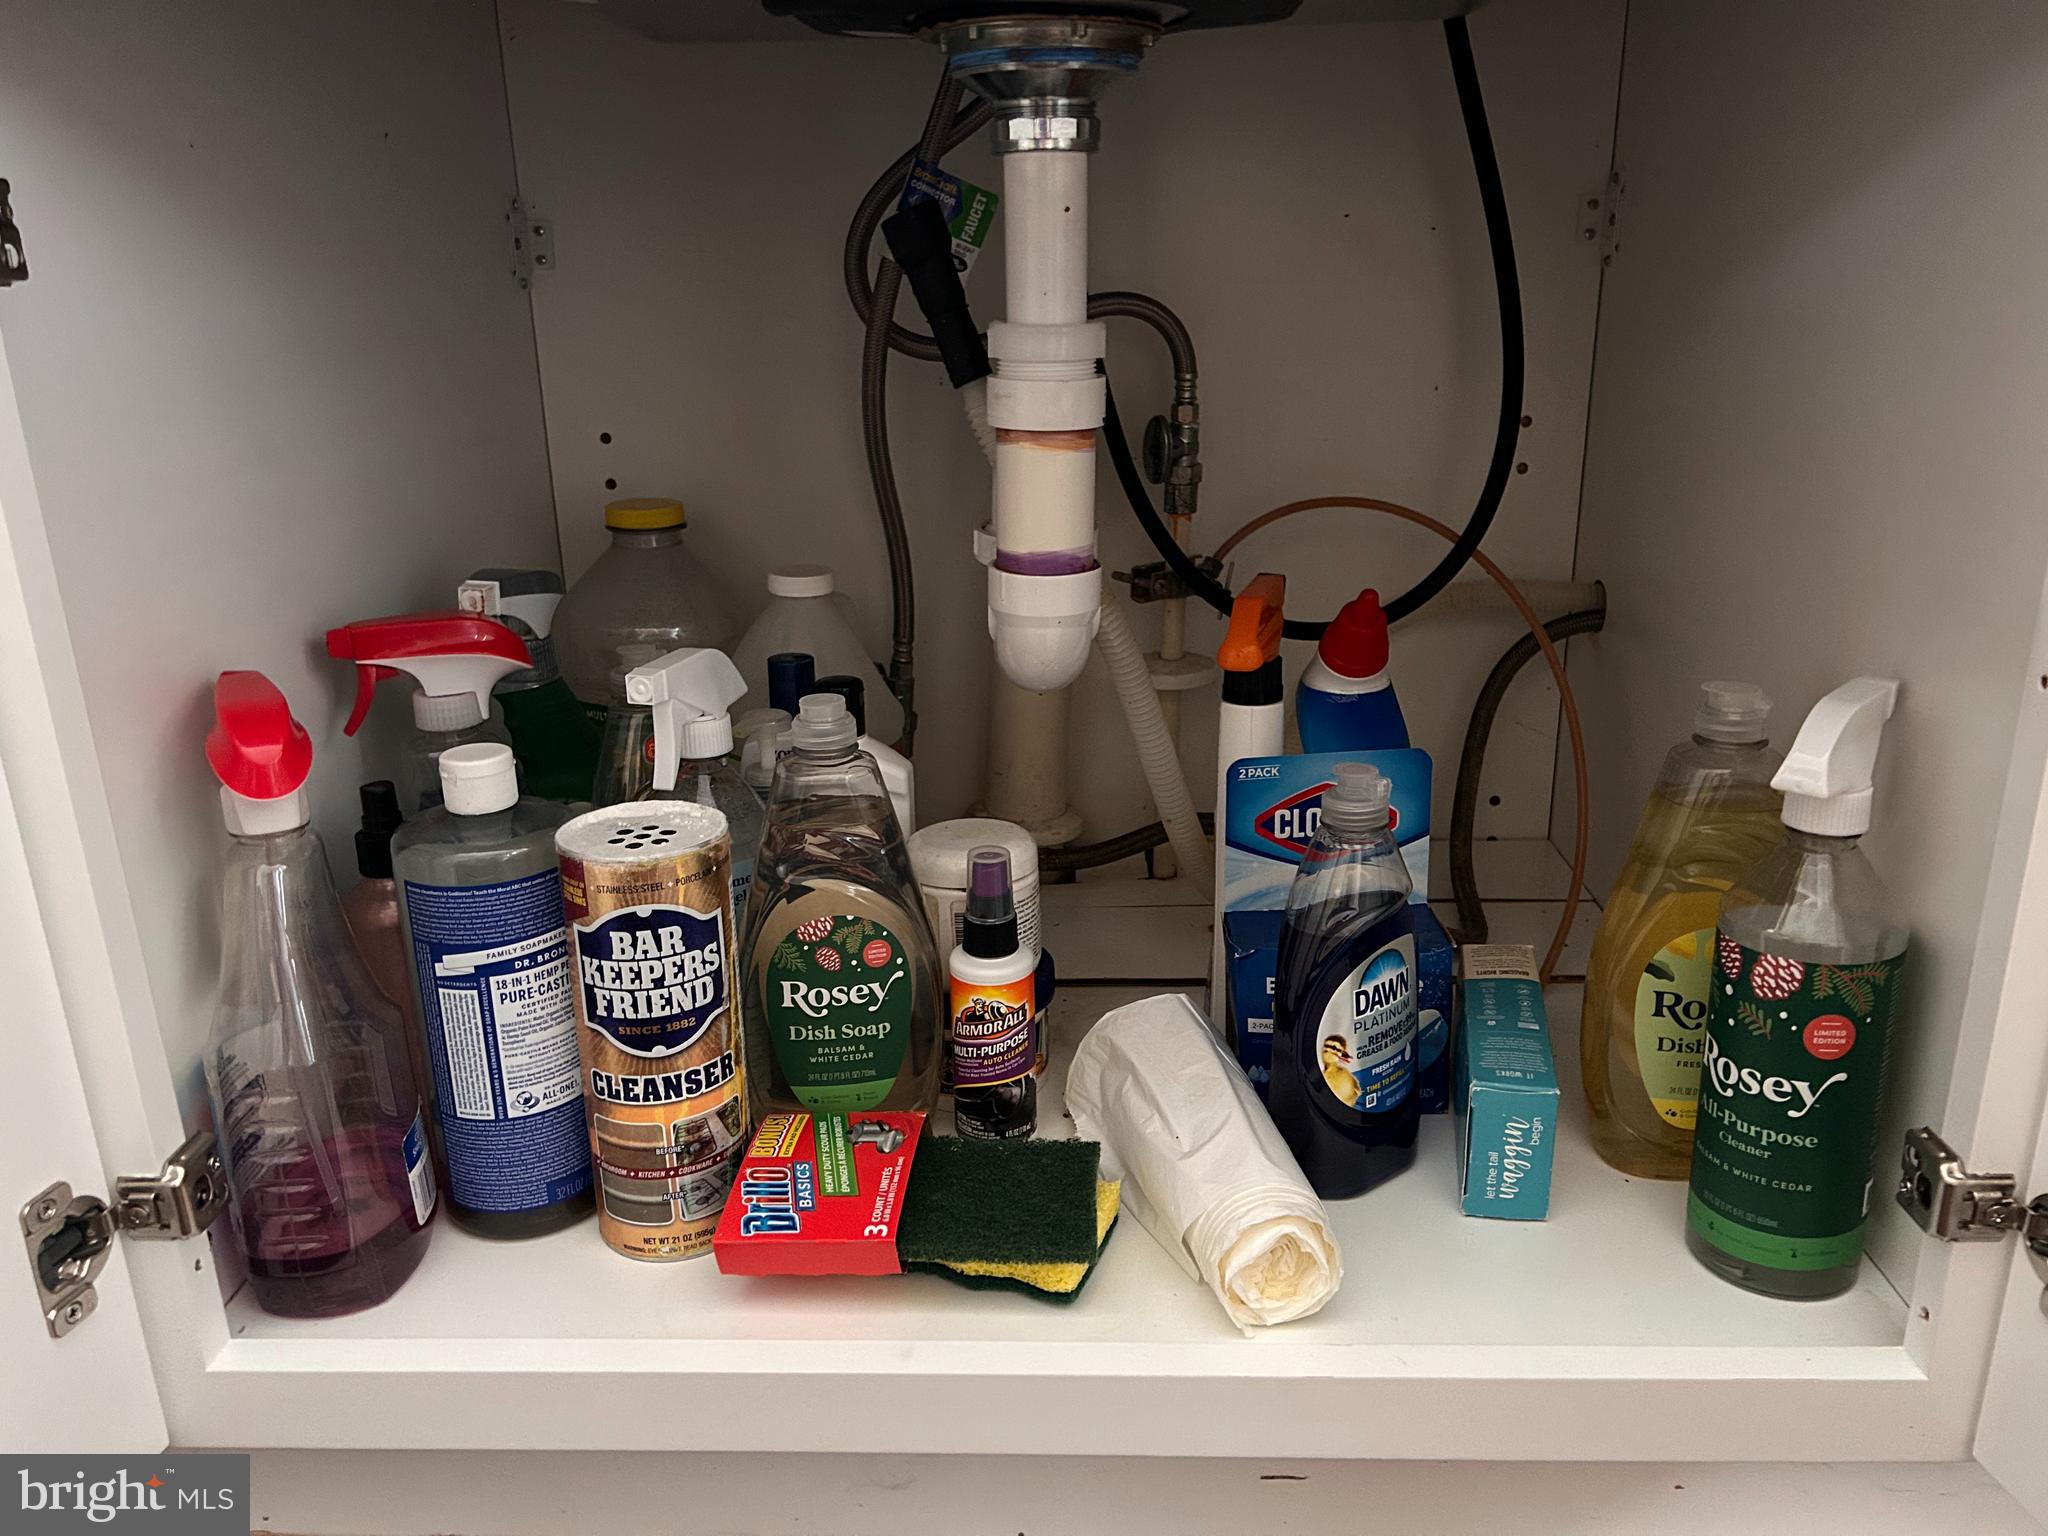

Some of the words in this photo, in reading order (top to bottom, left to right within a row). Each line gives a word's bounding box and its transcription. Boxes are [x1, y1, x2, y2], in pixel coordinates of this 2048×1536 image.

[961, 191, 987, 242] FAUCET
[1239, 769, 1246, 779] 2
[1248, 766, 1280, 778] PACK
[597, 884, 639, 895] STAINLESS
[639, 883, 665, 893] STEEL
[610, 925, 685, 961] BAR
[486, 948, 517, 960] FAMILY
[515, 959, 535, 970] DR.
[582, 941, 720, 990] KEEPERS
[496, 974, 531, 991] 18-IN-1
[534, 964, 559, 982] HEMP
[521, 993, 560, 1009] CERTIFIED
[594, 975, 715, 1019] FRIEND
[780, 970, 905, 1018] Rosey
[1354, 967, 1409, 1018] DAWN
[516, 1008, 538, 1017] MADE
[540, 1001, 558, 1011] WITH
[1354, 998, 1411, 1034] PLATINUM
[618, 1025, 662, 1035] SINCE
[666, 1017, 697, 1032] 1882
[789, 1024, 837, 1041] Dish
[841, 1021, 891, 1040] Soap
[1368, 1019, 1403, 1048] REMOVE
[1813, 1029, 1847, 1037] LIMITED
[817, 1046, 856, 1054] BALSAM
[954, 1027, 1029, 1058] MULTI-PURPOSE
[1813, 1037, 1847, 1045] EDITION
[809, 1055, 839, 1063] WHITE
[843, 1052, 874, 1062] CEDAR
[983, 1055, 1003, 1066] AUTO
[1003, 1041, 1029, 1060] CLEANER
[1357, 1045, 1384, 1060] GREASE
[591, 1051, 735, 1105] CLEANSER
[1372, 1060, 1390, 1076] FRESH
[1703, 1030, 1848, 1118] Rosey
[542, 1078, 578, 1101] ALL-ONE!
[1366, 1082, 1382, 1093] TIME
[1382, 1078, 1391, 1087] TO
[819, 1121, 828, 1134] PADS
[1701, 1092, 1819, 1148] All-Purpose
[750, 1113, 795, 1157] BONUS!
[1529, 1116, 1544, 1146] begin
[820, 1134, 830, 1155] SCOUR
[1719, 1130, 1773, 1159] Cleaner
[678, 1159, 713, 1175] COOKWARE
[822, 1155, 831, 1174] DUTY
[1488, 1151, 1499, 1166] tail
[799, 1163, 813, 1208] BASICS
[823, 1173, 834, 1193] HEAVY
[840, 1165, 851, 1193] ÉPONGES
[879, 1167, 893, 1192] UNITÉS
[1486, 1169, 1498, 1185] the
[1733, 1168, 1767, 1186] WHITE
[1772, 1180, 1814, 1193] CEDAR
[556, 1187, 566, 1200] 32
[567, 1183, 575, 1196] FL
[741, 1166, 800, 1237] Brillo
[1485, 1187, 1496, 1199] let
[872, 1196, 885, 1221] COUNT
[644, 1237, 656, 1245] NET
[658, 1237, 670, 1245] WT
[672, 1236, 681, 1244] 21
[682, 1233, 693, 1243] OZ
[864, 1225, 888, 1237] 3
